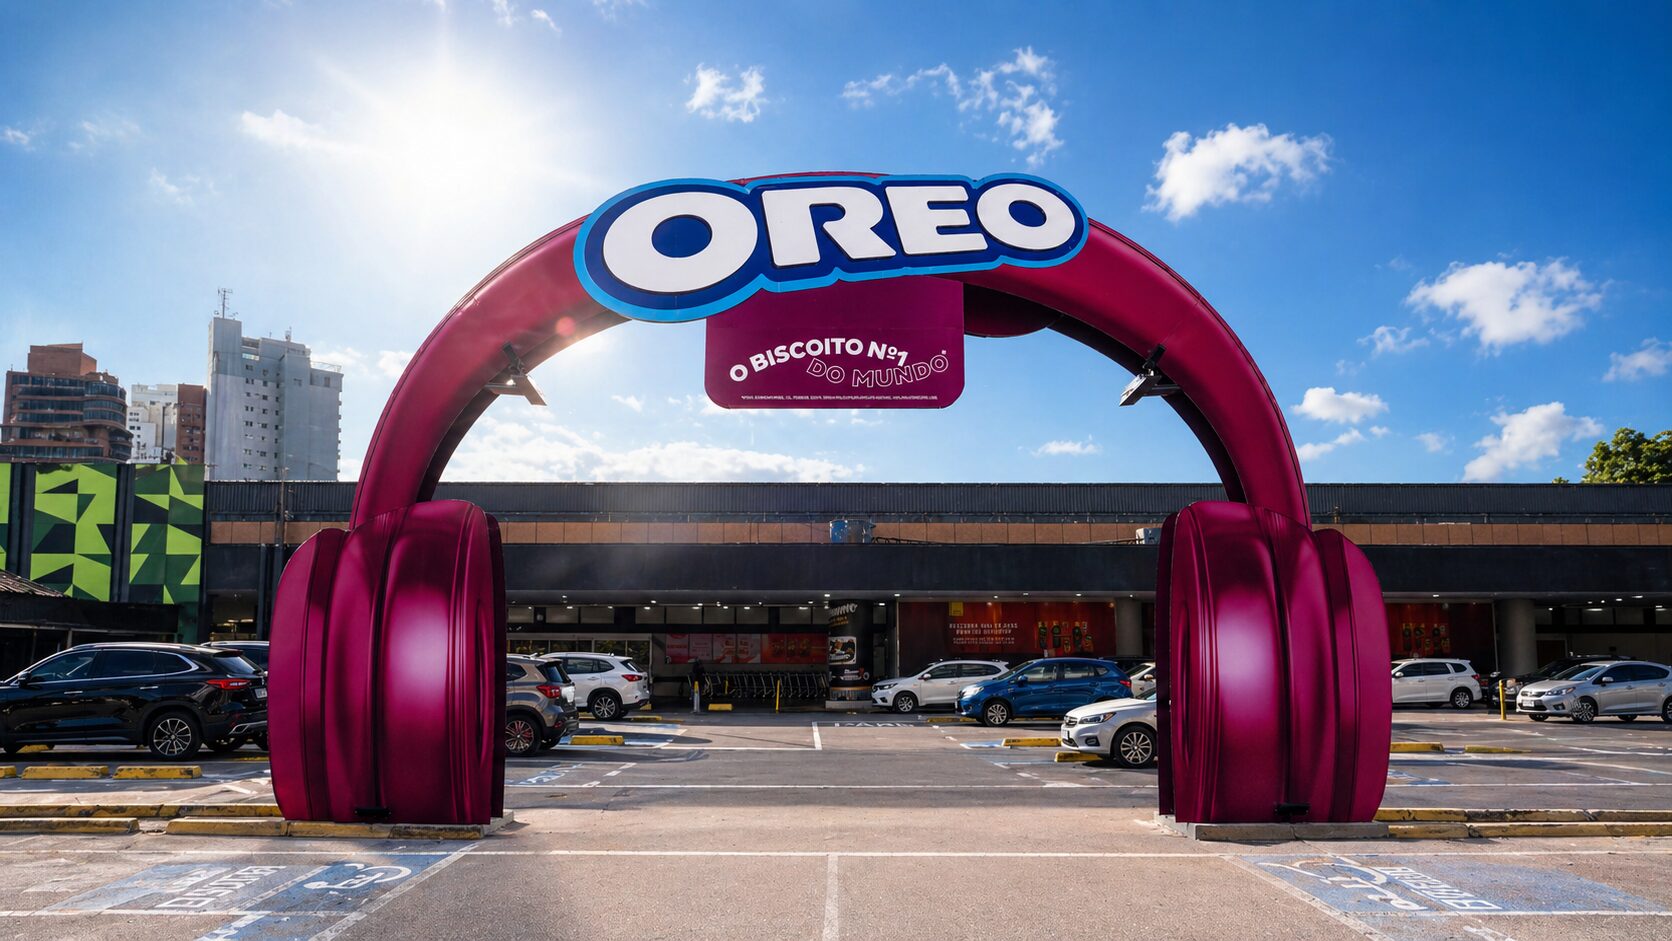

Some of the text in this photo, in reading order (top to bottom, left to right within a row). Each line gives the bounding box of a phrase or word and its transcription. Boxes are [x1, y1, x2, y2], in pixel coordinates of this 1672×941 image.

[603, 183, 1076, 293] OREO
[729, 364, 749, 382] O
[749, 337, 863, 372] BISCOITO
[806, 357, 846, 384] DO
